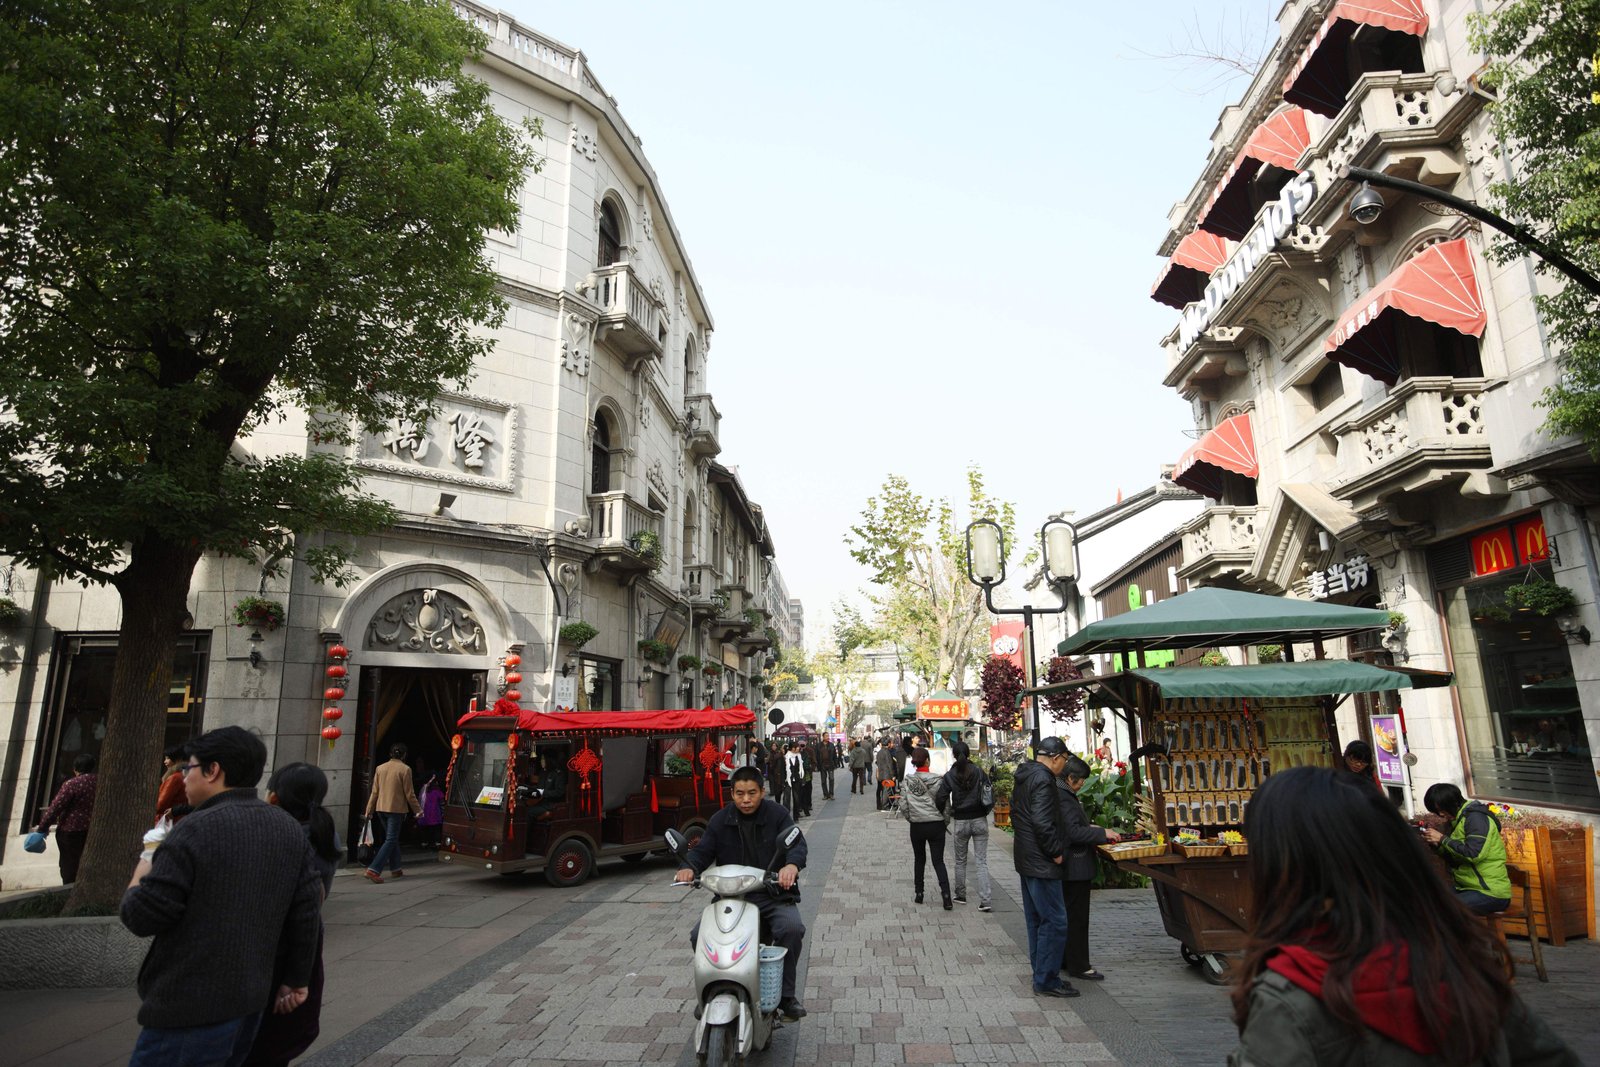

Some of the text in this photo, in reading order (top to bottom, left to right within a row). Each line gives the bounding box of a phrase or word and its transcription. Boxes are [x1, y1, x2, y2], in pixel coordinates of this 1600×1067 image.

[1178, 169, 1318, 355] McDonald's
[1306, 555, 1369, 601] 麦当劳
